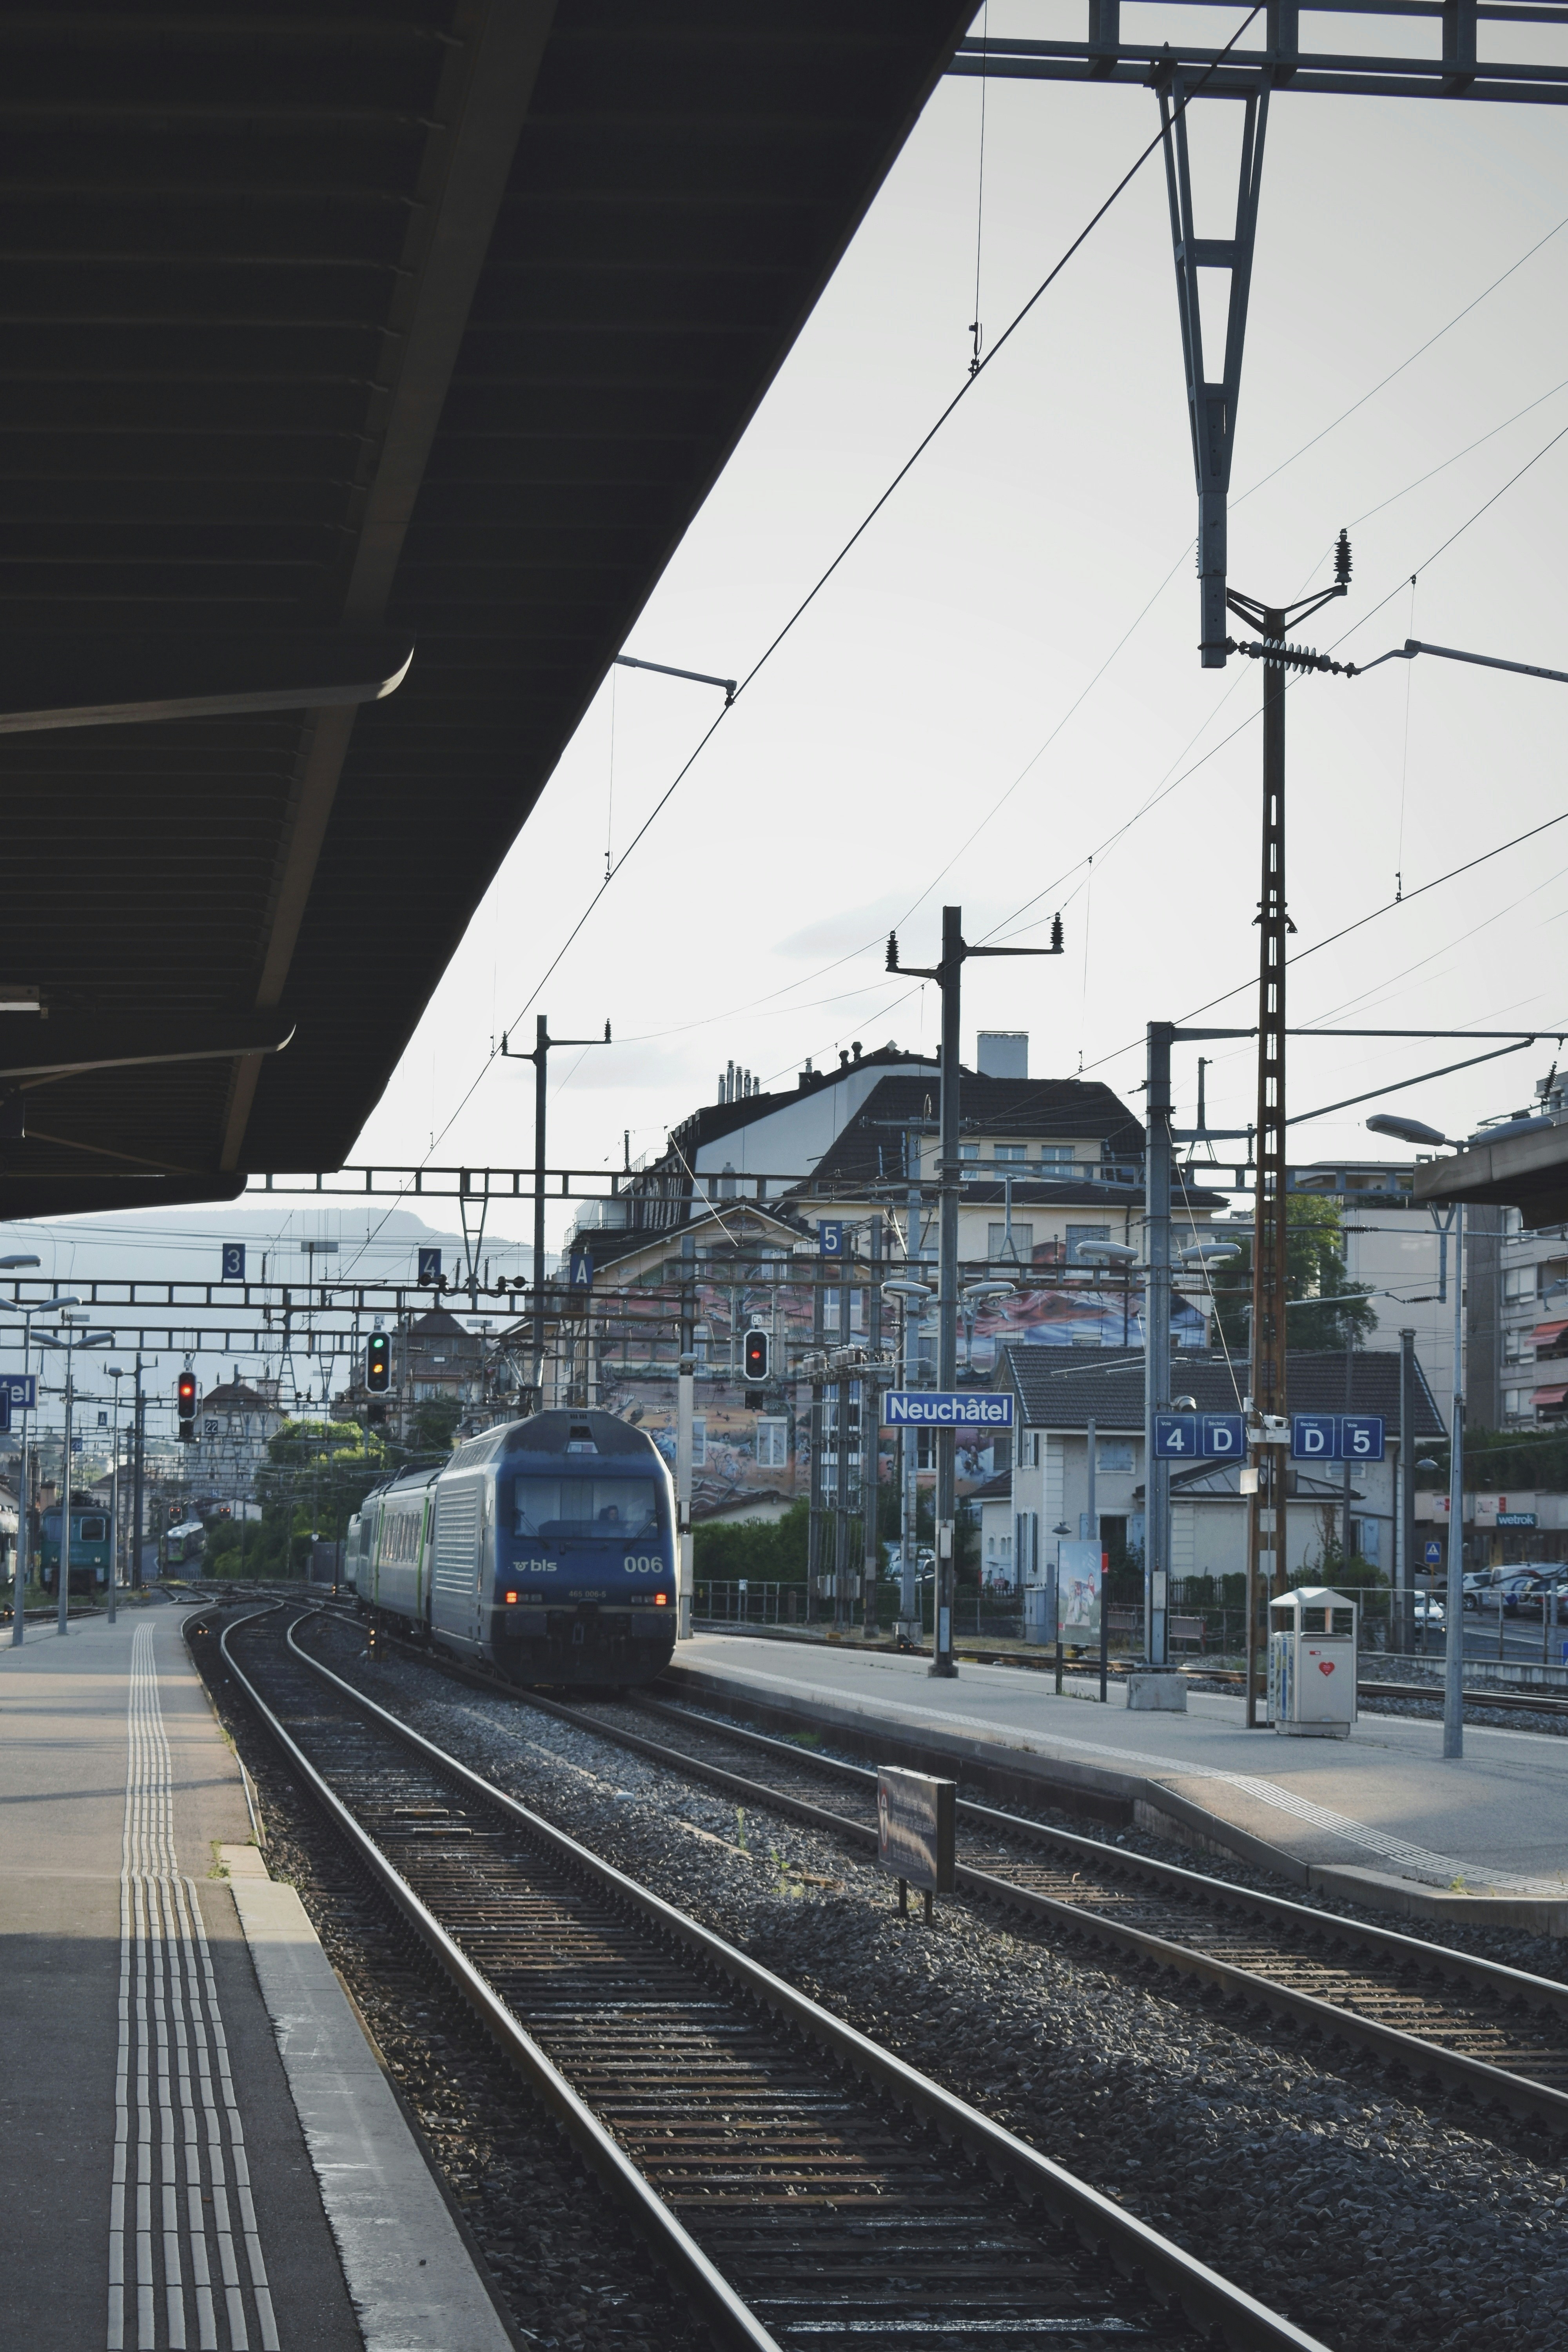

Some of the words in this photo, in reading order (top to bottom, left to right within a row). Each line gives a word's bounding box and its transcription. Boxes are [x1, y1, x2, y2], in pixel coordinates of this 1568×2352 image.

[824, 1227, 837, 1250] 5
[228, 1249, 240, 1273] 3
[424, 1254, 436, 1278] 4
[575, 1260, 587, 1284] A
[891, 1397, 1008, 1421] Neuchâtel
[206, 1422, 218, 1433] 22
[1166, 1428, 1185, 1451] 4
[1214, 1428, 1232, 1451] D
[1305, 1429, 1324, 1452] D
[1353, 1430, 1370, 1453] 5
[1499, 1515, 1534, 1524] wetrok
[530, 1559, 557, 1572] bls
[624, 1556, 663, 1573] 006
